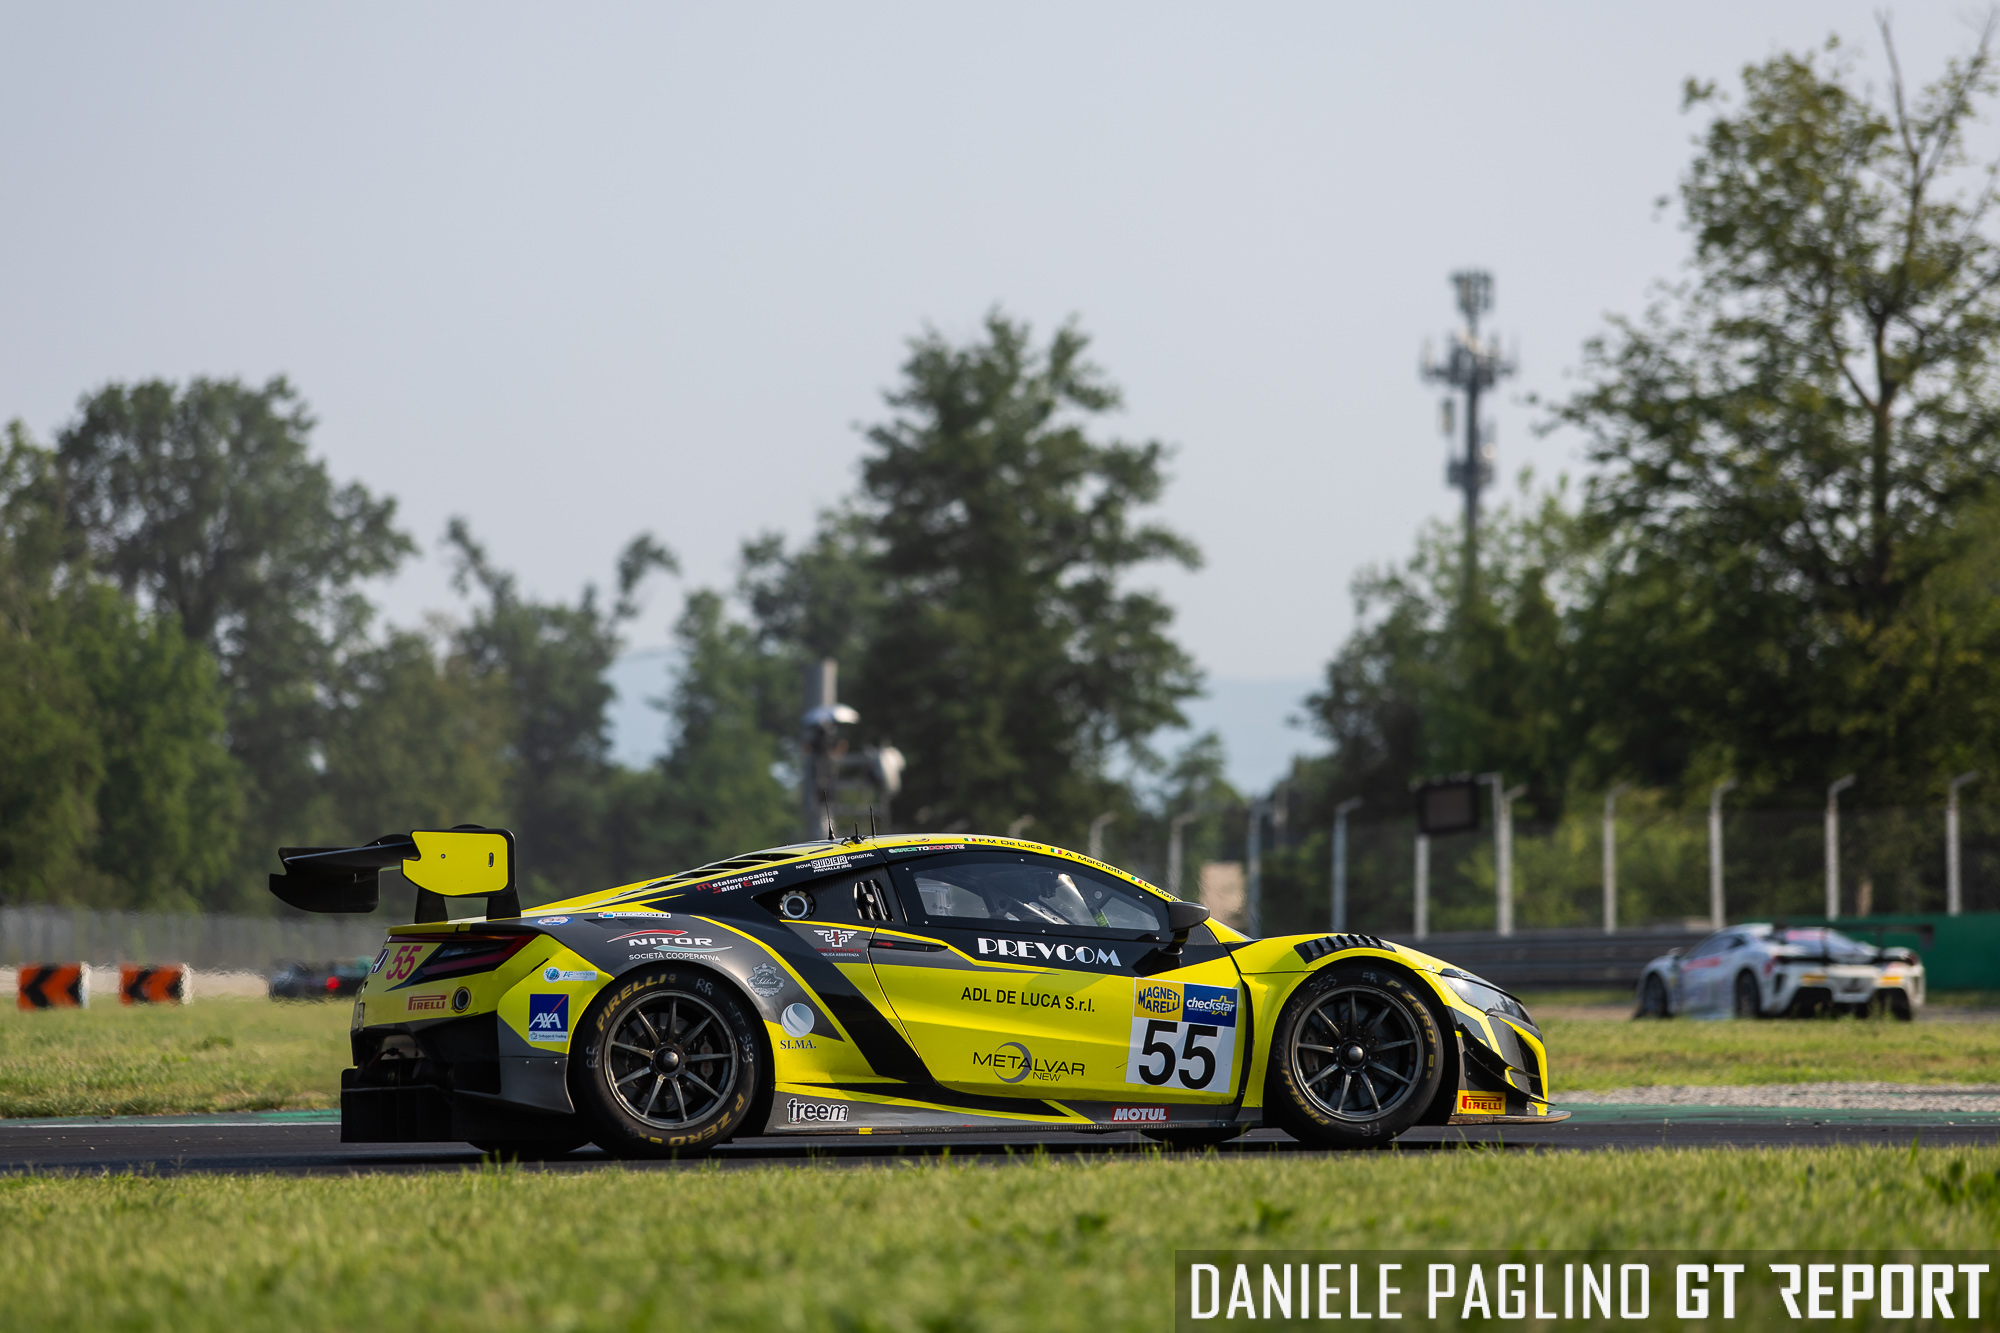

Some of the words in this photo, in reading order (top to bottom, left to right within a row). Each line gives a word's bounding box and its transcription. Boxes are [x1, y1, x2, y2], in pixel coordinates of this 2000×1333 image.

[811, 855, 848, 869] SIDER
[1077, 855, 1123, 876] Marchetti
[696, 870, 779, 891] Metalmeccanica
[712, 883, 742, 894] Saleri
[742, 877, 775, 888] Emilio
[629, 937, 712, 946] NITOR
[629, 951, 664, 961] SOCIETÀ
[666, 952, 721, 962] COOPERATIVA
[978, 938, 1121, 967] PREVCOM
[386, 945, 423, 980] 55
[408, 995, 447, 1011] PIRELLI
[596, 973, 667, 1032] PIRELLI
[961, 987, 991, 1002] ADL
[996, 990, 1016, 1004] DE
[1021, 992, 1061, 1009] LUCA
[1065, 997, 1095, 1012] S.r.l.
[1138, 986, 1180, 1003] MAGNETI
[1138, 999, 1180, 1013] MARELLI
[1186, 997, 1235, 1012] checkstar
[1386, 980, 1402, 989] P
[1401, 990, 1437, 1044] ZERO
[528, 1013, 562, 1029] AXA
[780, 1040, 817, 1050] SI.MA.
[1139, 1019, 1218, 1090] 55
[973, 1052, 1085, 1076] METALVAR
[1032, 1072, 1061, 1082] NEW
[736, 1092, 744, 1112] P
[1281, 1069, 1330, 1126] PIRELLI
[1462, 1095, 1502, 1110] PIRELLI
[788, 1099, 848, 1121] freem
[1113, 1108, 1167, 1120] MOTUL
[668, 1112, 732, 1147] ZERO
